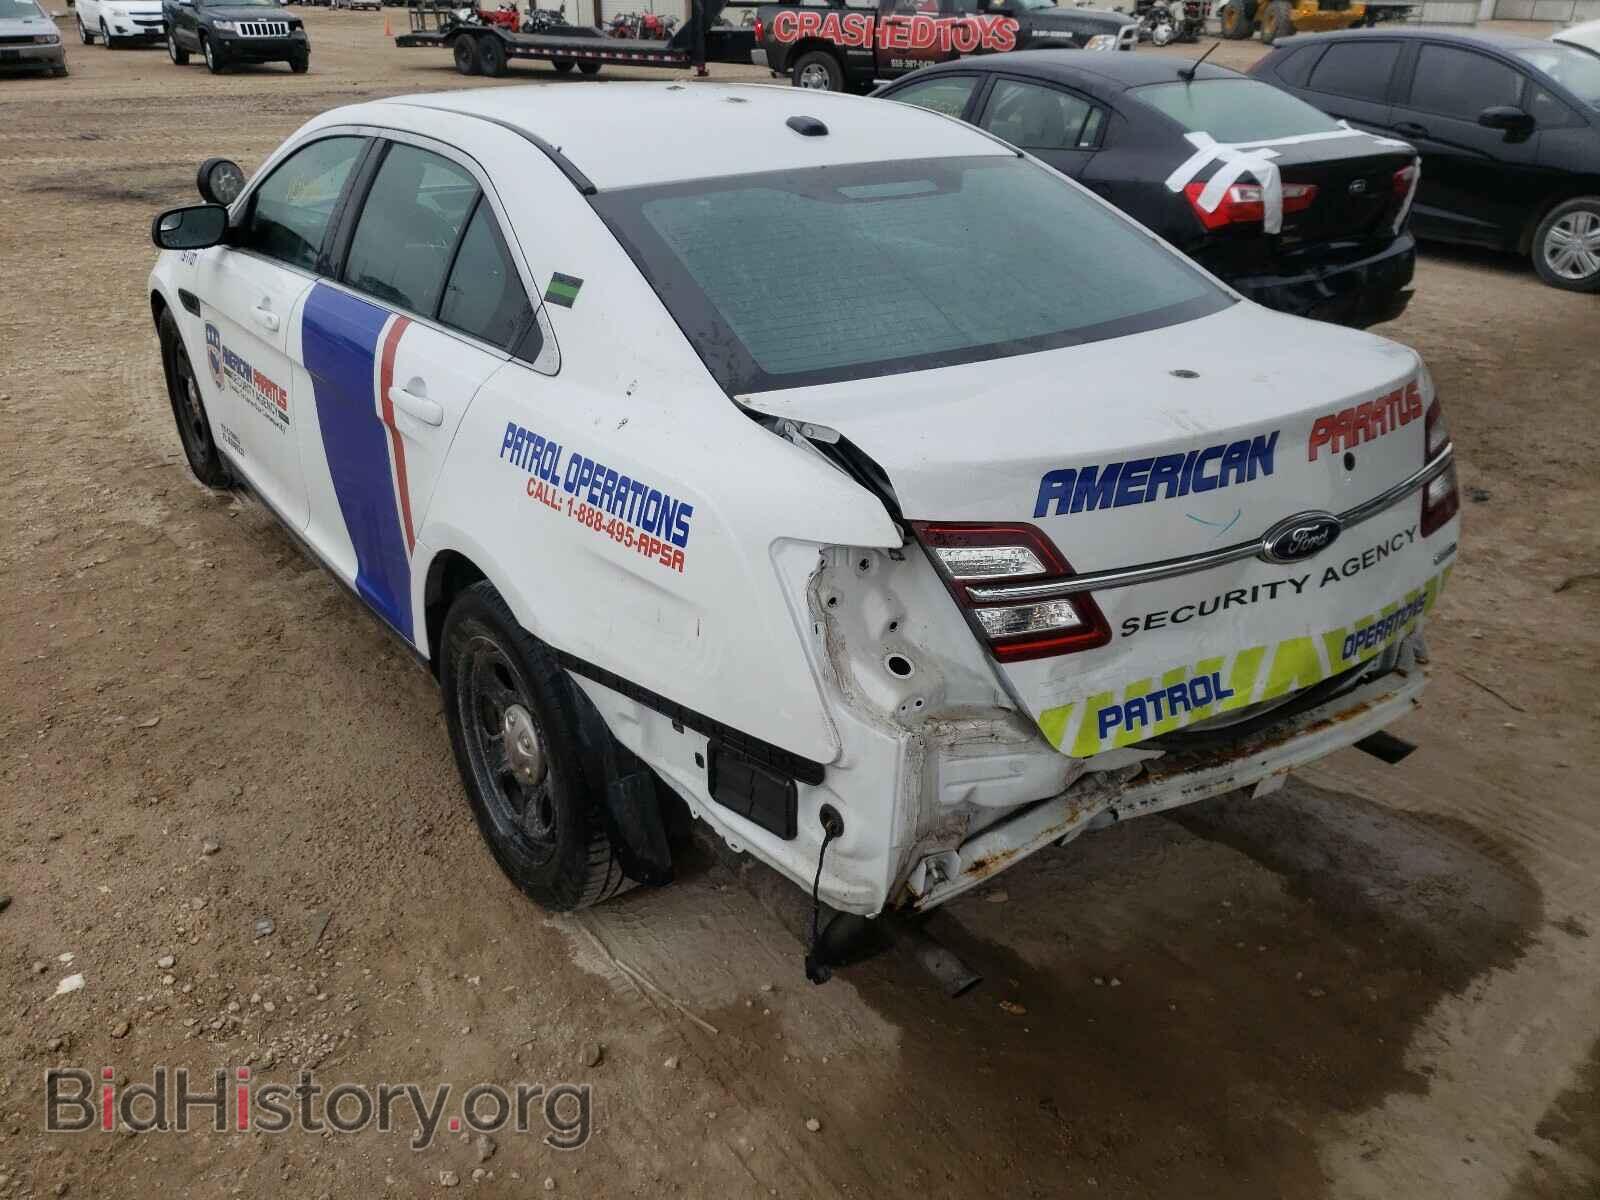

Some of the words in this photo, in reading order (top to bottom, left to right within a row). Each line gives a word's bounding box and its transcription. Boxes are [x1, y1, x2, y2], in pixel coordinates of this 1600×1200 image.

[773, 11, 1020, 52] CRASHEDTOYS
[500, 421, 563, 487] PATROL
[563, 452, 695, 548] OPERATIONS
[1033, 430, 1280, 518] AMERICAN
[1308, 380, 1422, 462] PARATUS
[526, 477, 563, 512] CALL:
[567, 497, 686, 573] 1-888-495-APSA
[1288, 524, 1329, 554] Ford
[1121, 574, 1312, 637] SECURITY
[1319, 525, 1418, 588] AGENCY
[1098, 672, 1234, 739] PATROL
